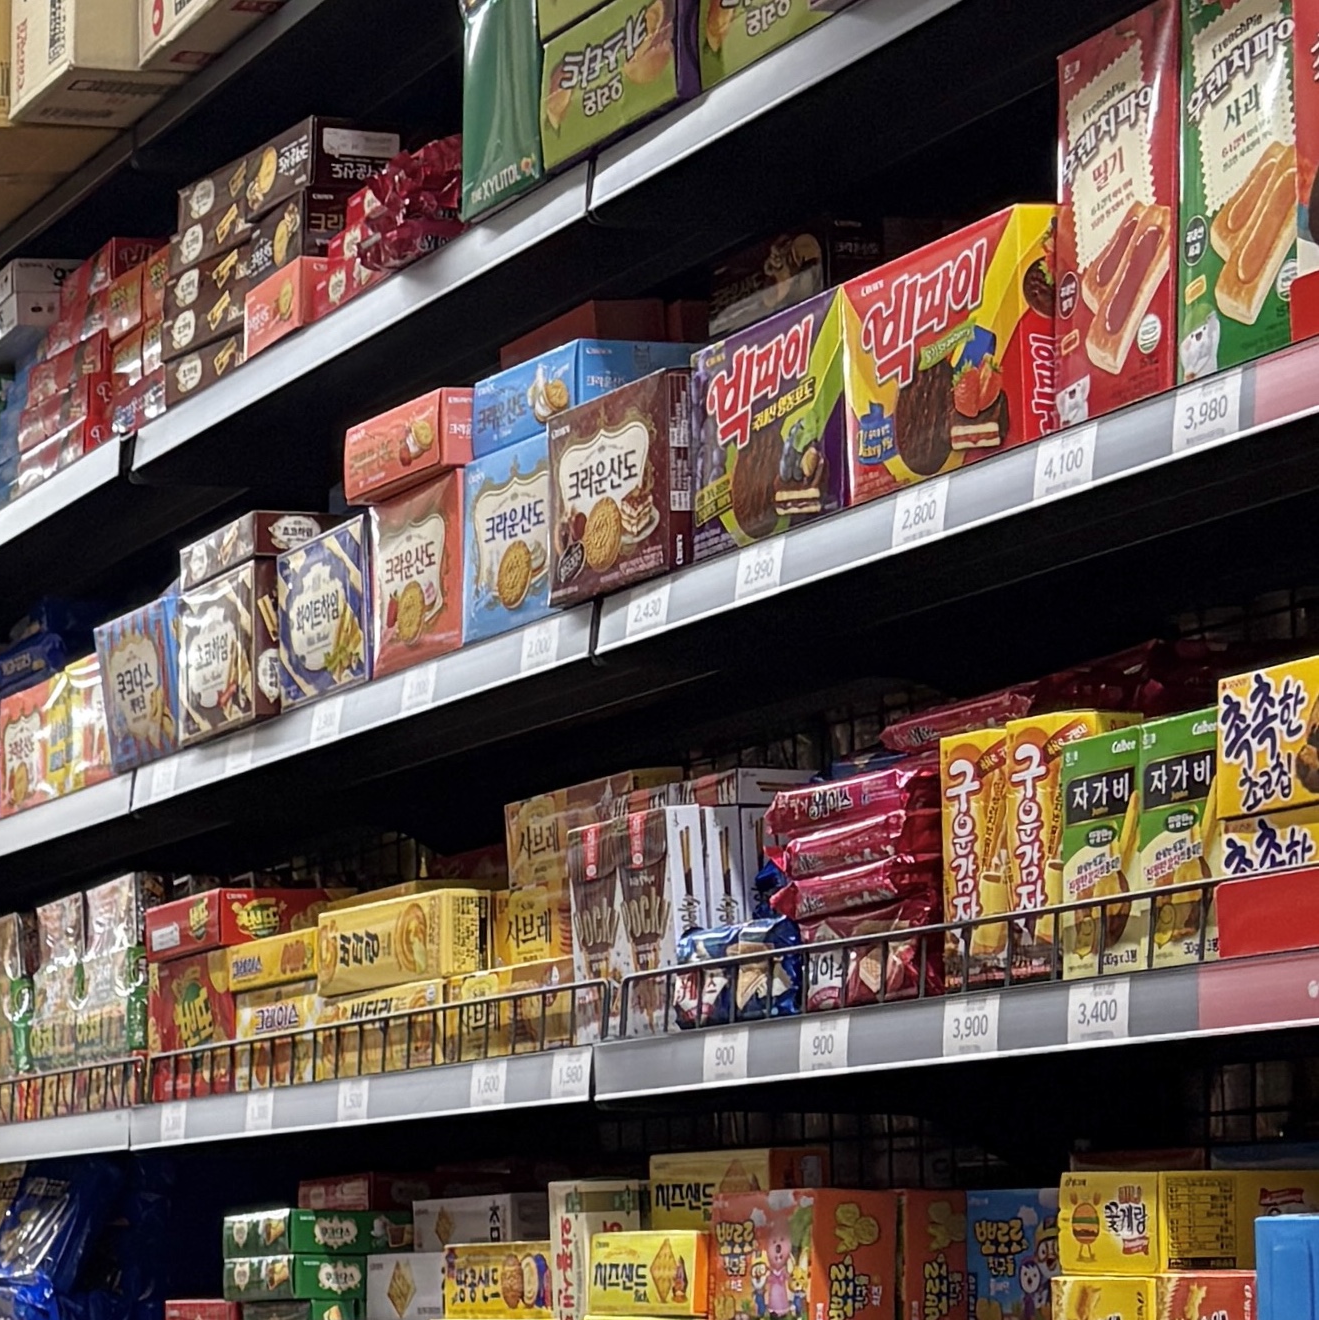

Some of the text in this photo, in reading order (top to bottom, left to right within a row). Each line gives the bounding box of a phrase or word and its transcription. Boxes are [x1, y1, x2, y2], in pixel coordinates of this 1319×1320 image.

[560, 11, 648, 91] 카스타드
[1211, 12, 1263, 60] FrenchPie
[1187, 17, 1294, 123] 후렌치파이
[583, 75, 624, 118] 오리온
[1082, 79, 1127, 126] FrenchPie
[1222, 82, 1262, 132] 사과
[1061, 86, 1153, 184] 후렌치파이
[482, 167, 522, 201] XYLITOL
[1091, 147, 1126, 193] 딸기
[861, 237, 989, 390] 빅파이
[706, 314, 815, 450] 빅파이
[1181, 395, 1231, 433] 3,980
[567, 448, 640, 503] 크라운산도
[1043, 446, 1088, 483] 4,100
[483, 496, 547, 545] 크라운산도
[900, 500, 938, 532] 2,800
[385, 540, 437, 586] 크라운산도
[744, 559, 776, 586] 2,990
[292, 588, 341, 636] 화이트하임
[632, 595, 662, 624] 2,430
[115, 661, 154, 698] 쿠크다스
[1220, 674, 1308, 768] 촉촉한
[1111, 737, 1137, 755] Calbee
[1070, 775, 1131, 811] 자가비
[1148, 754, 1213, 796] 자가비
[1239, 752, 1293, 813] 초코칩
[518, 821, 560, 857] 사브레
[945, 758, 982, 923] 구운감자
[1010, 742, 1048, 920] 구운감자
[505, 906, 553, 950] 사브레
[952, 1014, 989, 1039] 3,900
[1076, 998, 1119, 1025] 3,400
[714, 1045, 735, 1066] 900
[812, 1034, 835, 1056] 900
[475, 1074, 500, 1093] 1,600
[655, 1180, 714, 1212] 치즈샌드
[716, 1219, 757, 1252] 뽀로로
[974, 1217, 1029, 1253] 뽀로로
[1104, 1200, 1148, 1236] 꽃게랑
[454, 1263, 501, 1302] 땅콩샌드
[594, 1261, 648, 1293] 치즈샌드
[722, 1255, 743, 1276] 친구들
[987, 1255, 1015, 1277] 친구들
